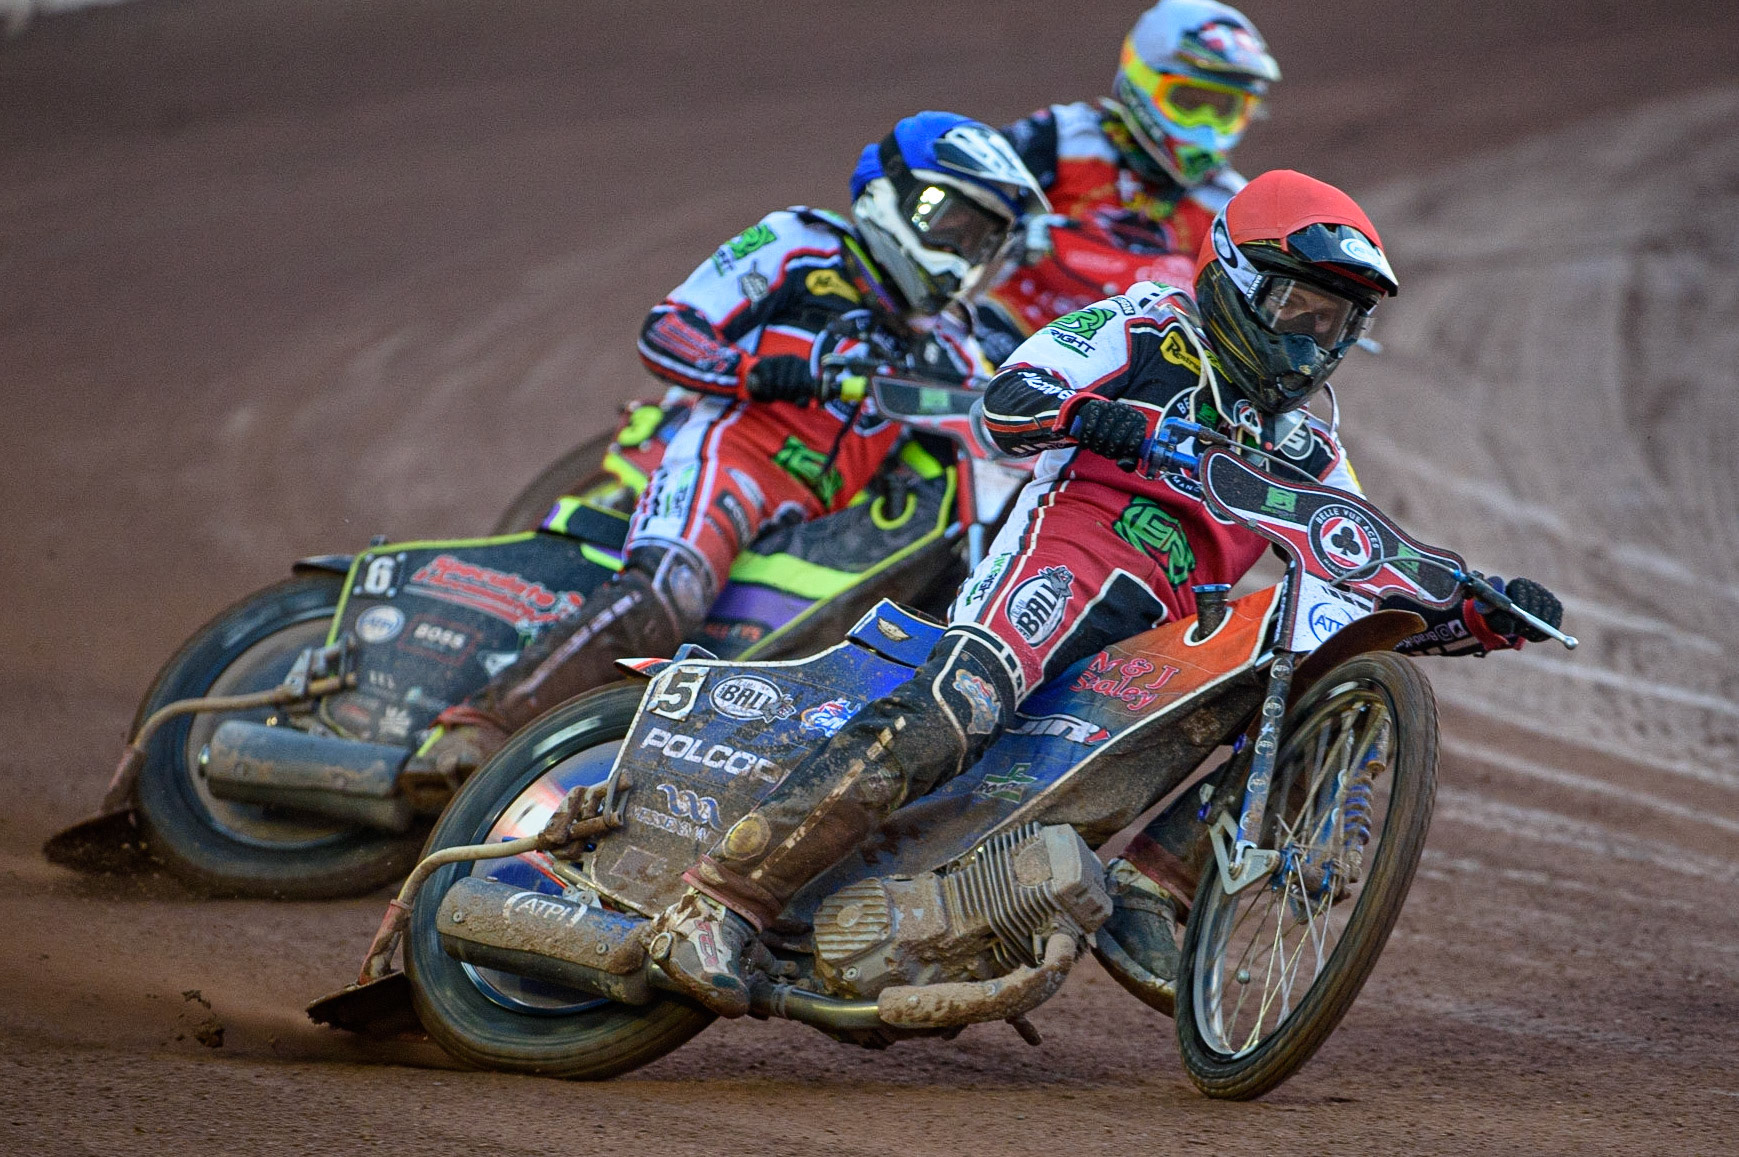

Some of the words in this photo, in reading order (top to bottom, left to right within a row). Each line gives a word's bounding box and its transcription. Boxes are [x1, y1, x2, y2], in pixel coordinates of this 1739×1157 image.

[1315, 507, 1340, 525] BELLE
[1343, 508, 1362, 524] VUE
[1363, 525, 1380, 549] ACES
[364, 555, 395, 595] 6
[657, 668, 693, 713] 5
[1120, 657, 1154, 678] &
[1145, 664, 1180, 690] J
